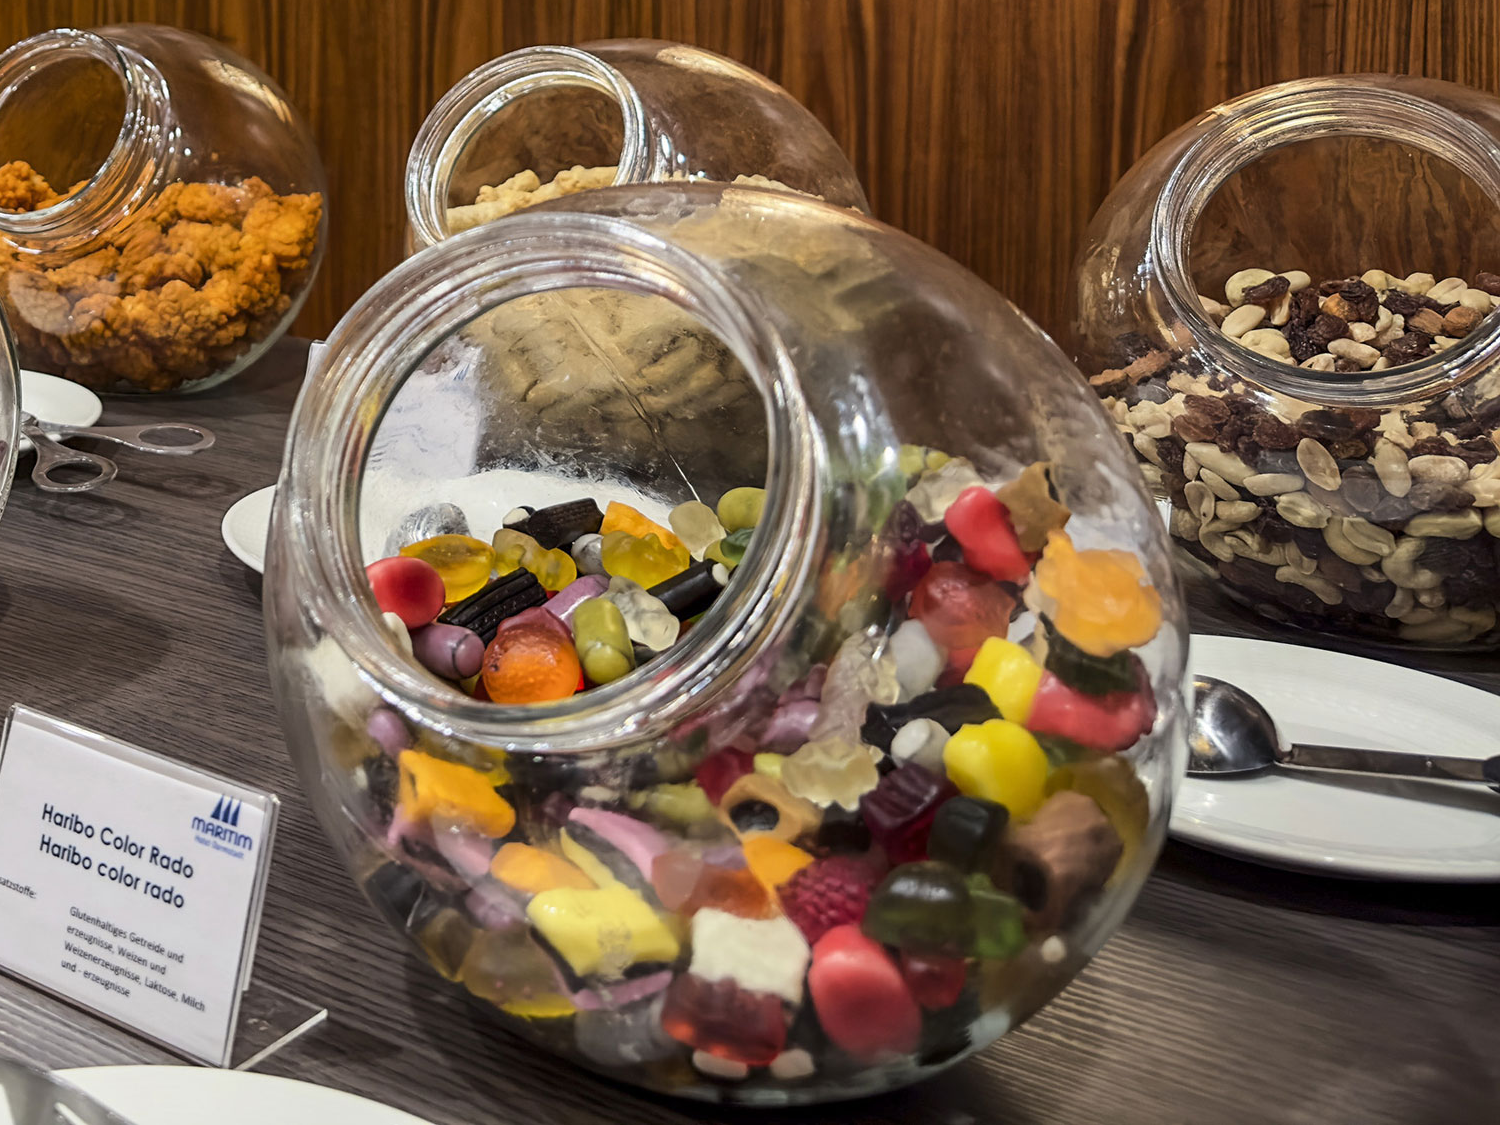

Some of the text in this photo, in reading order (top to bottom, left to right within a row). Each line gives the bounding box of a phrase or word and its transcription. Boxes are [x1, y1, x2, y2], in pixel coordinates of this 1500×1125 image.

[41, 803, 195, 879] Haribo Color Rado
[191, 816, 253, 851] MARITIM
[39, 833, 185, 909] Haribo color rado
[66, 925, 167, 976] erzeugnisse, Weizen und
[69, 906, 185, 963] Glutenhaltiges Getreide und
[61, 958, 77, 973] und
[83, 969, 131, 998] erzeugnisse
[64, 940, 206, 1013] Weizenerzeugnisse, Laktose, Milch
